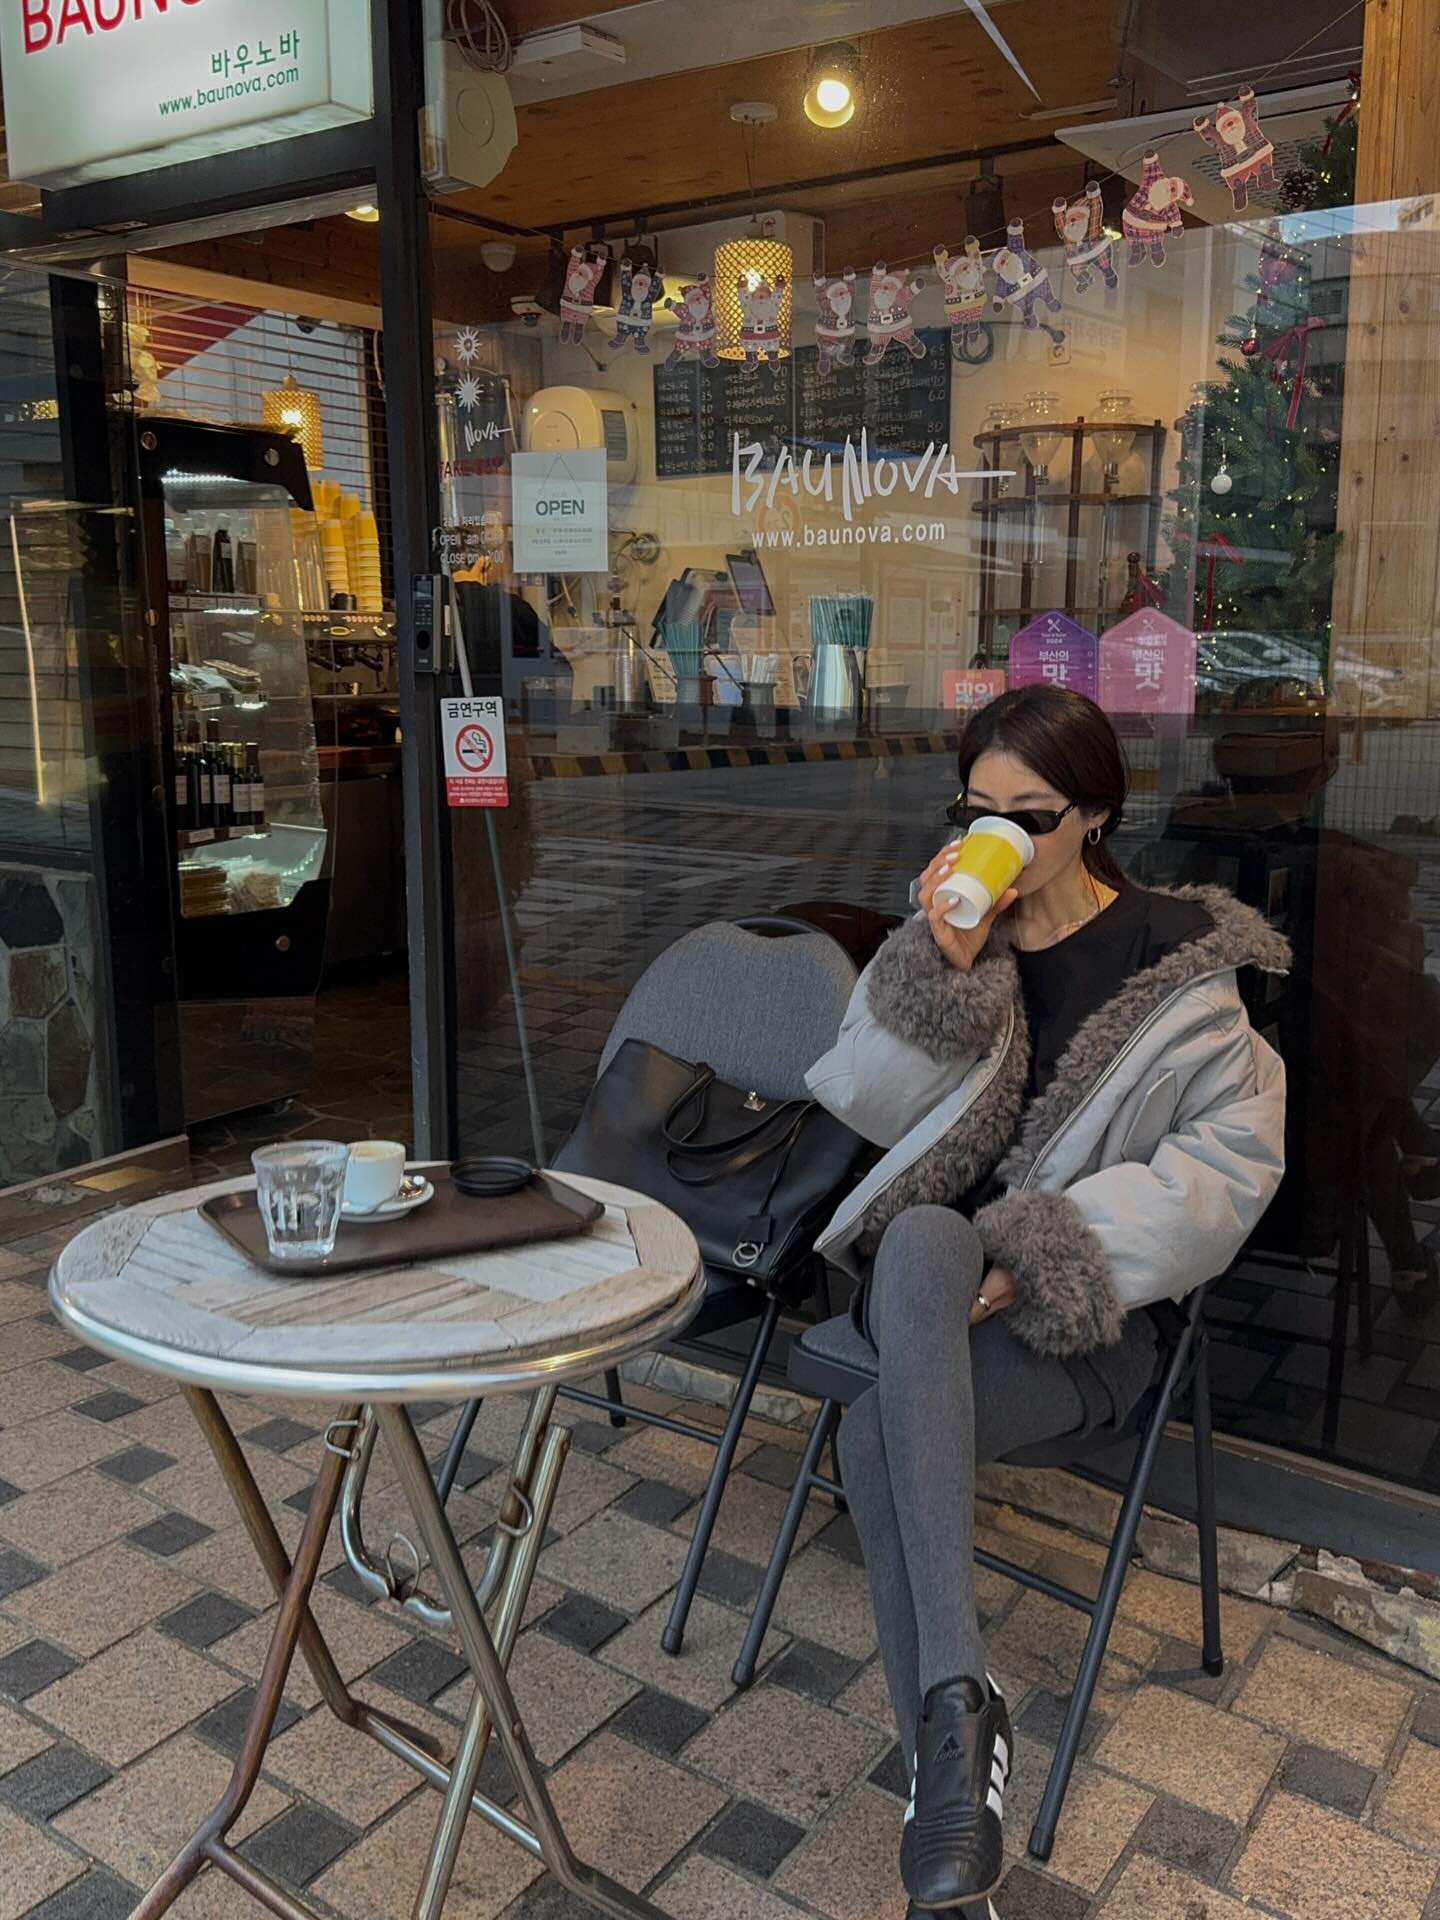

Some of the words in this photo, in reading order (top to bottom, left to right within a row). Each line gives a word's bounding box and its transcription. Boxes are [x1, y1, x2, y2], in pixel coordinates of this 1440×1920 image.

[22, 0, 205, 54] BAU
[211, 30, 300, 78] 바우노바
[159, 67, 299, 115] www.baunova.com
[535, 500, 585, 516] OPEN
[752, 521, 945, 549] www.baunova.com
[1039, 650, 1069, 662] 부산의
[1042, 663, 1069, 689] 맛
[1135, 662, 1163, 689] 맛
[447, 701, 498, 718] 금연구역
